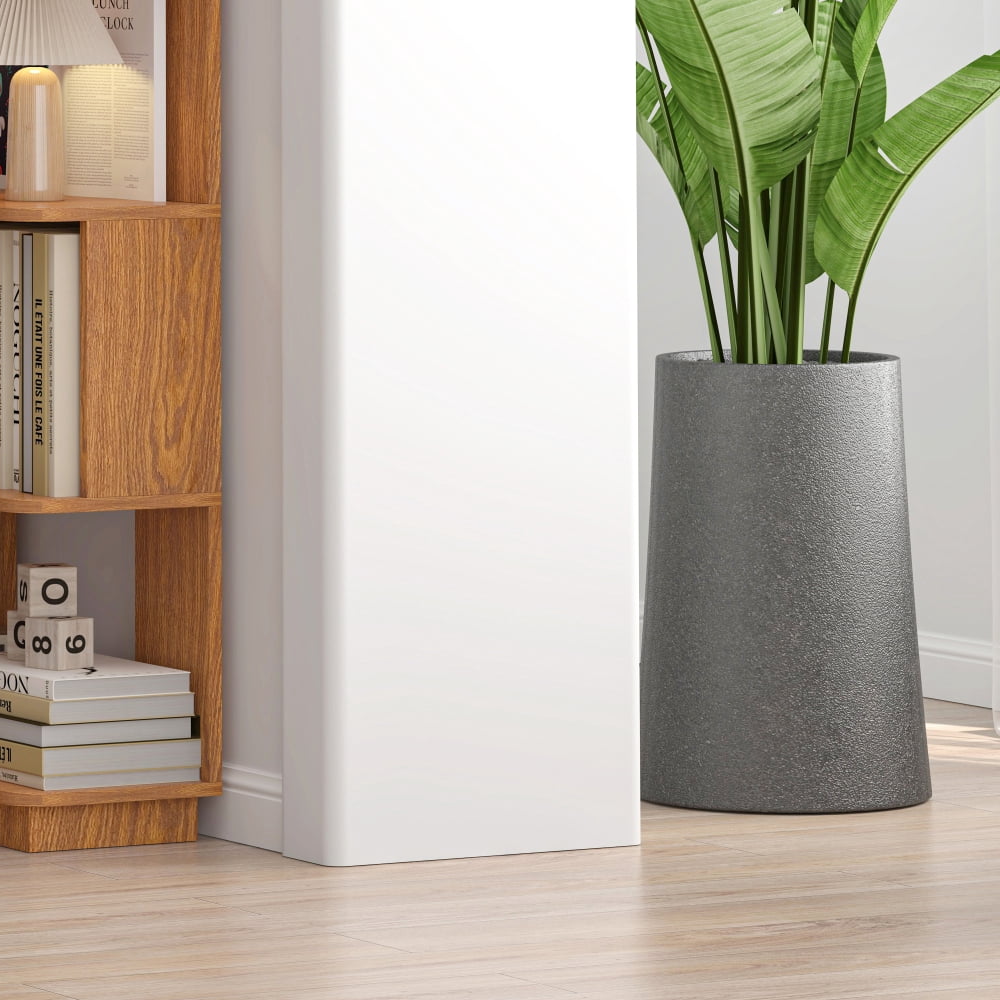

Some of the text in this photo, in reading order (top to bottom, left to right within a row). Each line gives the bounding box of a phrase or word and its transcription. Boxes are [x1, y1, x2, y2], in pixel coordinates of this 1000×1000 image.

[34, 298, 43, 308] IL
[34, 347, 43, 367] UNE
[34, 372, 43, 397] FOIS
[34, 401, 43, 414] LE
[34, 418, 43, 446] CAFÉ
[32, 635, 52, 655] 8
